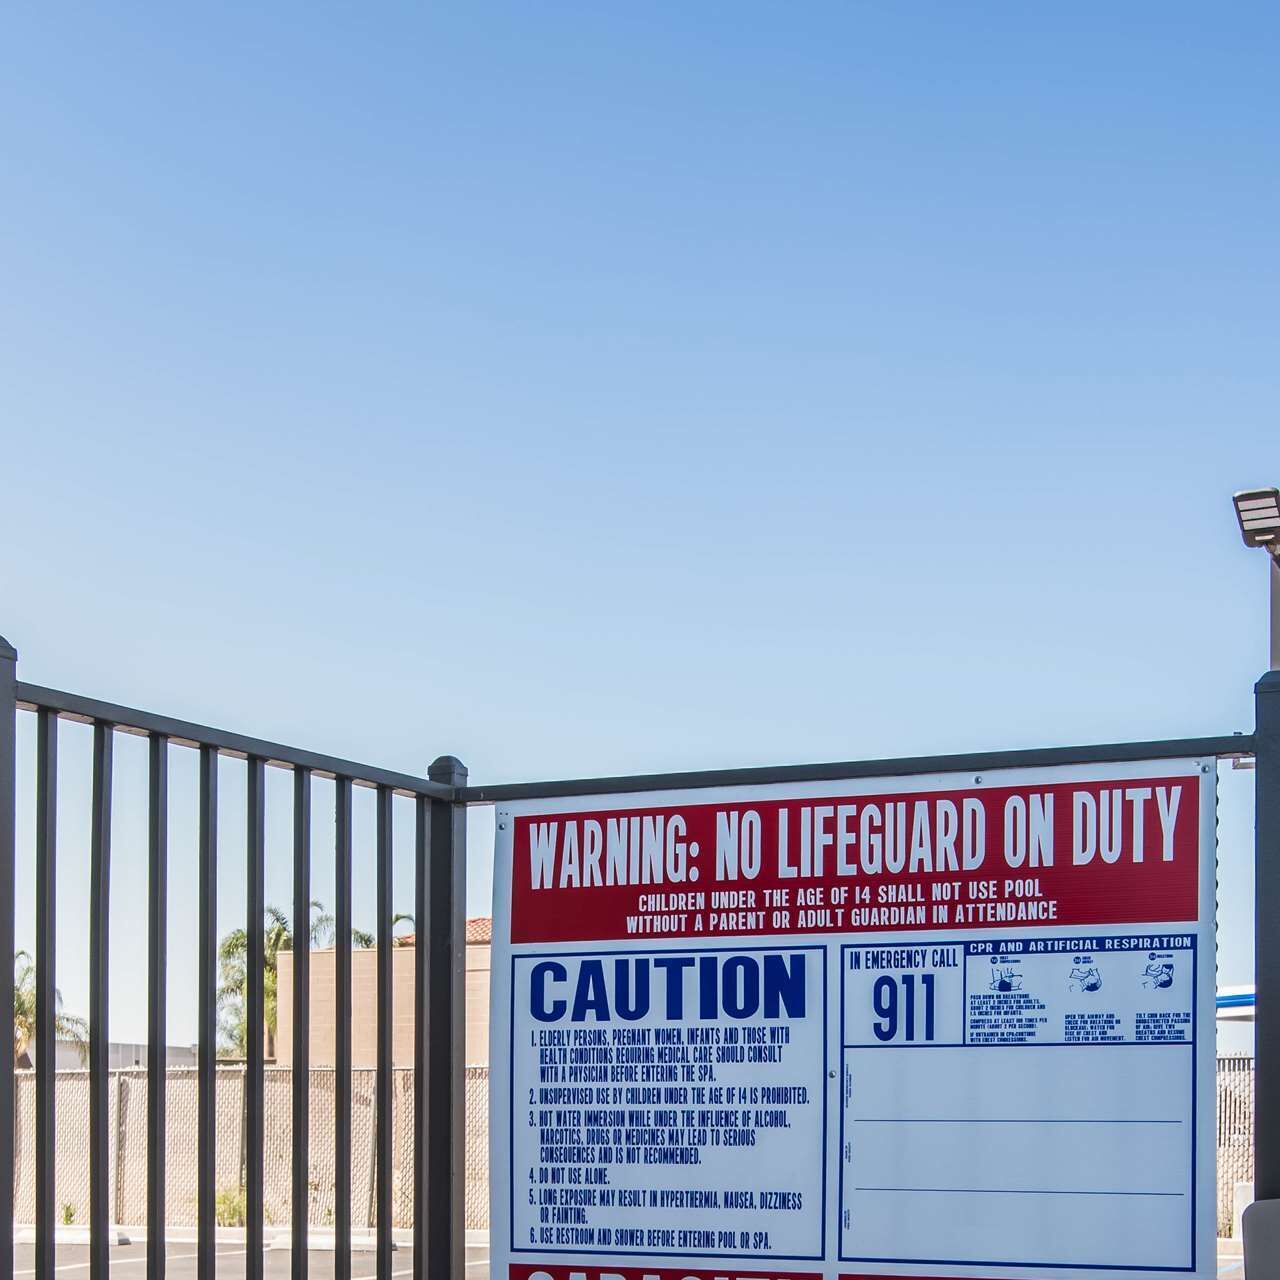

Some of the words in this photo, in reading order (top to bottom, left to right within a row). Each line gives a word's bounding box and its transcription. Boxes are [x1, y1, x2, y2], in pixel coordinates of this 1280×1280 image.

[528, 813, 699, 889] WARNING:
[715, 809, 762, 881] NO
[777, 796, 986, 879] LIFEGUARD
[1003, 793, 1054, 868] ON
[1072, 785, 1181, 865] DUTY
[639, 892, 704, 912] CHILDREN
[711, 890, 756, 909] UNDER
[763, 889, 789, 907] THE
[797, 887, 824, 906] AGE
[831, 886, 848, 904] OF
[855, 886, 870, 903] 14
[878, 883, 924, 903] SHALL
[932, 882, 961, 901] NOT
[969, 880, 997, 899] USE
[1005, 878, 1042, 897] POOL
[626, 914, 687, 933] WITHOUT
[694, 914, 702, 931] A
[709, 911, 765, 930] PARENT
[773, 910, 790, 928] OR
[798, 908, 844, 928] ADULT
[851, 906, 926, 926] GUARDIAN
[932, 905, 947, 923] IN
[955, 901, 1057, 922] ATTENDANCE
[970, 942, 992, 952] CPR
[999, 942, 1022, 951] AND
[1029, 939, 1099, 951] ARTIFICIAL
[1105, 936, 1190, 948] RESPIRATION
[850, 951, 860, 969] IN
[865, 948, 926, 969] EMERGENCY
[932, 948, 957, 967] CALL
[530, 953, 806, 1022] CAUTION
[873, 973, 934, 1041] 911
[539, 1029, 570, 1047] ELDERLY
[612, 1028, 650, 1046] PREGNANT
[687, 1027, 720, 1045] INFANTS
[723, 1027, 738, 1044] AND
[742, 1026, 766, 1044] THOSE
[769, 1026, 789, 1044] WITH
[539, 1047, 567, 1064] HEALTH
[569, 1047, 613, 1064] CONDITIONS
[615, 1046, 654, 1064] REQUIRING
[657, 1046, 689, 1063] MEDICAL
[693, 1045, 712, 1063] CARE
[716, 1045, 744, 1063] SHOULD
[747, 1045, 782, 1063] CONSULT
[539, 1065, 558, 1083] WITH
[561, 1065, 565, 1082] A
[568, 1065, 608, 1083] PHYSICIAN
[610, 1065, 638, 1082] BEFORE
[641, 1064, 677, 1082] ENTERING
[680, 1064, 695, 1082] THE
[539, 1087, 593, 1104] UNSUPERVISED
[596, 1087, 609, 1104] USE
[612, 1087, 622, 1104] BY
[625, 1087, 661, 1104] CHILDREN
[664, 1087, 687, 1104] UNDER
[691, 1087, 705, 1104] THE
[708, 1086, 723, 1104] AGE
[726, 1086, 735, 1104] OF
[738, 1086, 746, 1104] 14
[750, 1086, 758, 1104] IS
[539, 1109, 552, 1127] HOT
[556, 1110, 581, 1127] WATER
[584, 1109, 625, 1127] IMMERSION
[628, 1109, 650, 1127] WHILE
[653, 1110, 677, 1127] UNDER
[681, 1109, 695, 1127] THE
[698, 1109, 738, 1127] INFLUENCE
[741, 1110, 751, 1127] OF
[586, 1128, 610, 1145] DRUGS
[612, 1128, 622, 1145] OR
[625, 1128, 665, 1146] MEDICINES
[668, 1128, 684, 1146] MAY
[687, 1128, 707, 1146] LEAD
[710, 1128, 720, 1146] TO
[723, 1128, 755, 1146] SERIOUS
[540, 1146, 595, 1163] CONSEQUENCES
[598, 1146, 612, 1163] AND
[615, 1146, 623, 1164] IS
[626, 1146, 640, 1164] NOT
[539, 1166, 548, 1184] DO
[551, 1166, 564, 1184] NOT
[568, 1167, 581, 1184] USE
[539, 1188, 557, 1205] LONG
[559, 1188, 596, 1206] EXPOSURE
[599, 1189, 615, 1206] MAY
[618, 1189, 646, 1207] RESULT
[649, 1189, 657, 1207] IN
[759, 1191, 802, 1210] DIZZINESS
[540, 1206, 549, 1223] OR
[539, 1226, 553, 1244] USE
[556, 1226, 594, 1245] RESTROOM
[597, 1227, 611, 1246] AND
[614, 1228, 644, 1246] SHOWER
[647, 1229, 674, 1247] BEFORE
[678, 1229, 715, 1248] ENTERING
[717, 1230, 736, 1248] POOL
[740, 1231, 749, 1249] OR
